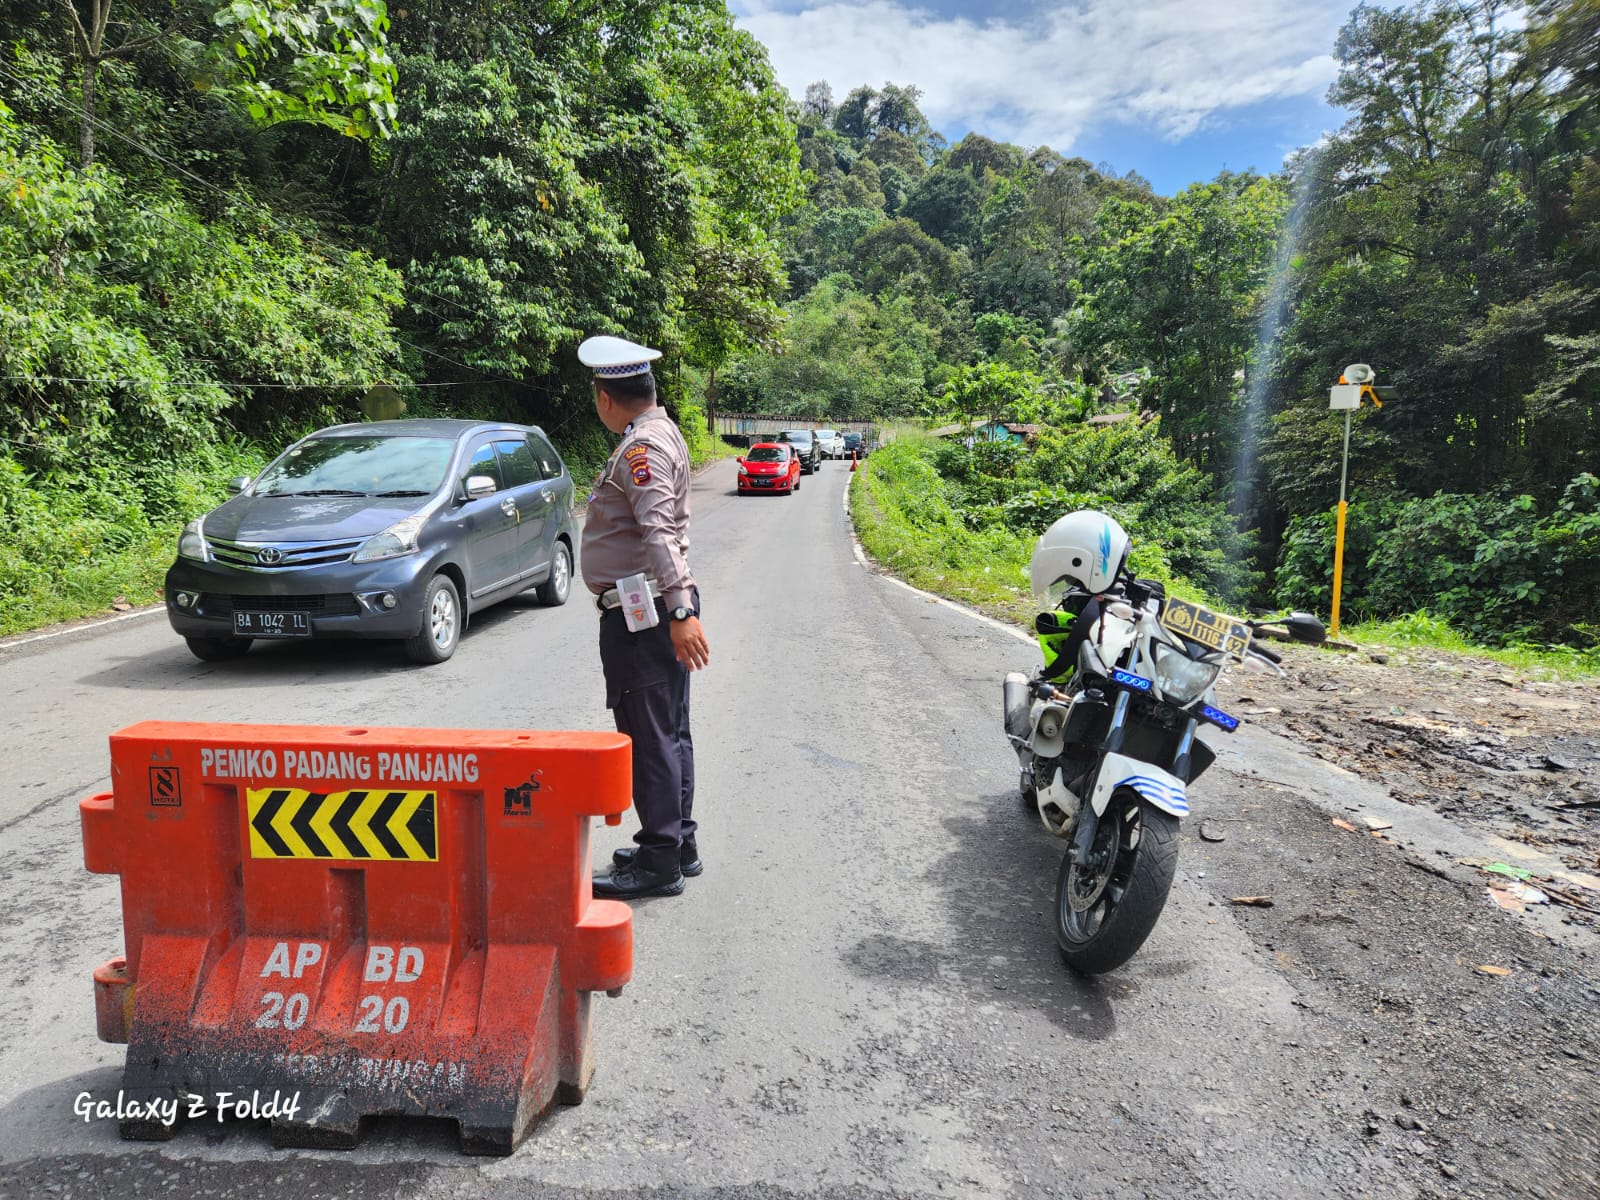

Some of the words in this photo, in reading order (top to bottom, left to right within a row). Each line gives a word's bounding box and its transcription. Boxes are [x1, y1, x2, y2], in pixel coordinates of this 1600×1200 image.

[237, 613, 252, 627] BA
[259, 614, 285, 628] 1042
[293, 614, 306, 628] IL
[200, 748, 277, 778] PEMKO
[283, 750, 371, 780] PADANG
[260, 942, 322, 978] AP
[364, 946, 425, 983] BD
[255, 991, 309, 1031] 20
[354, 995, 410, 1034] 20
